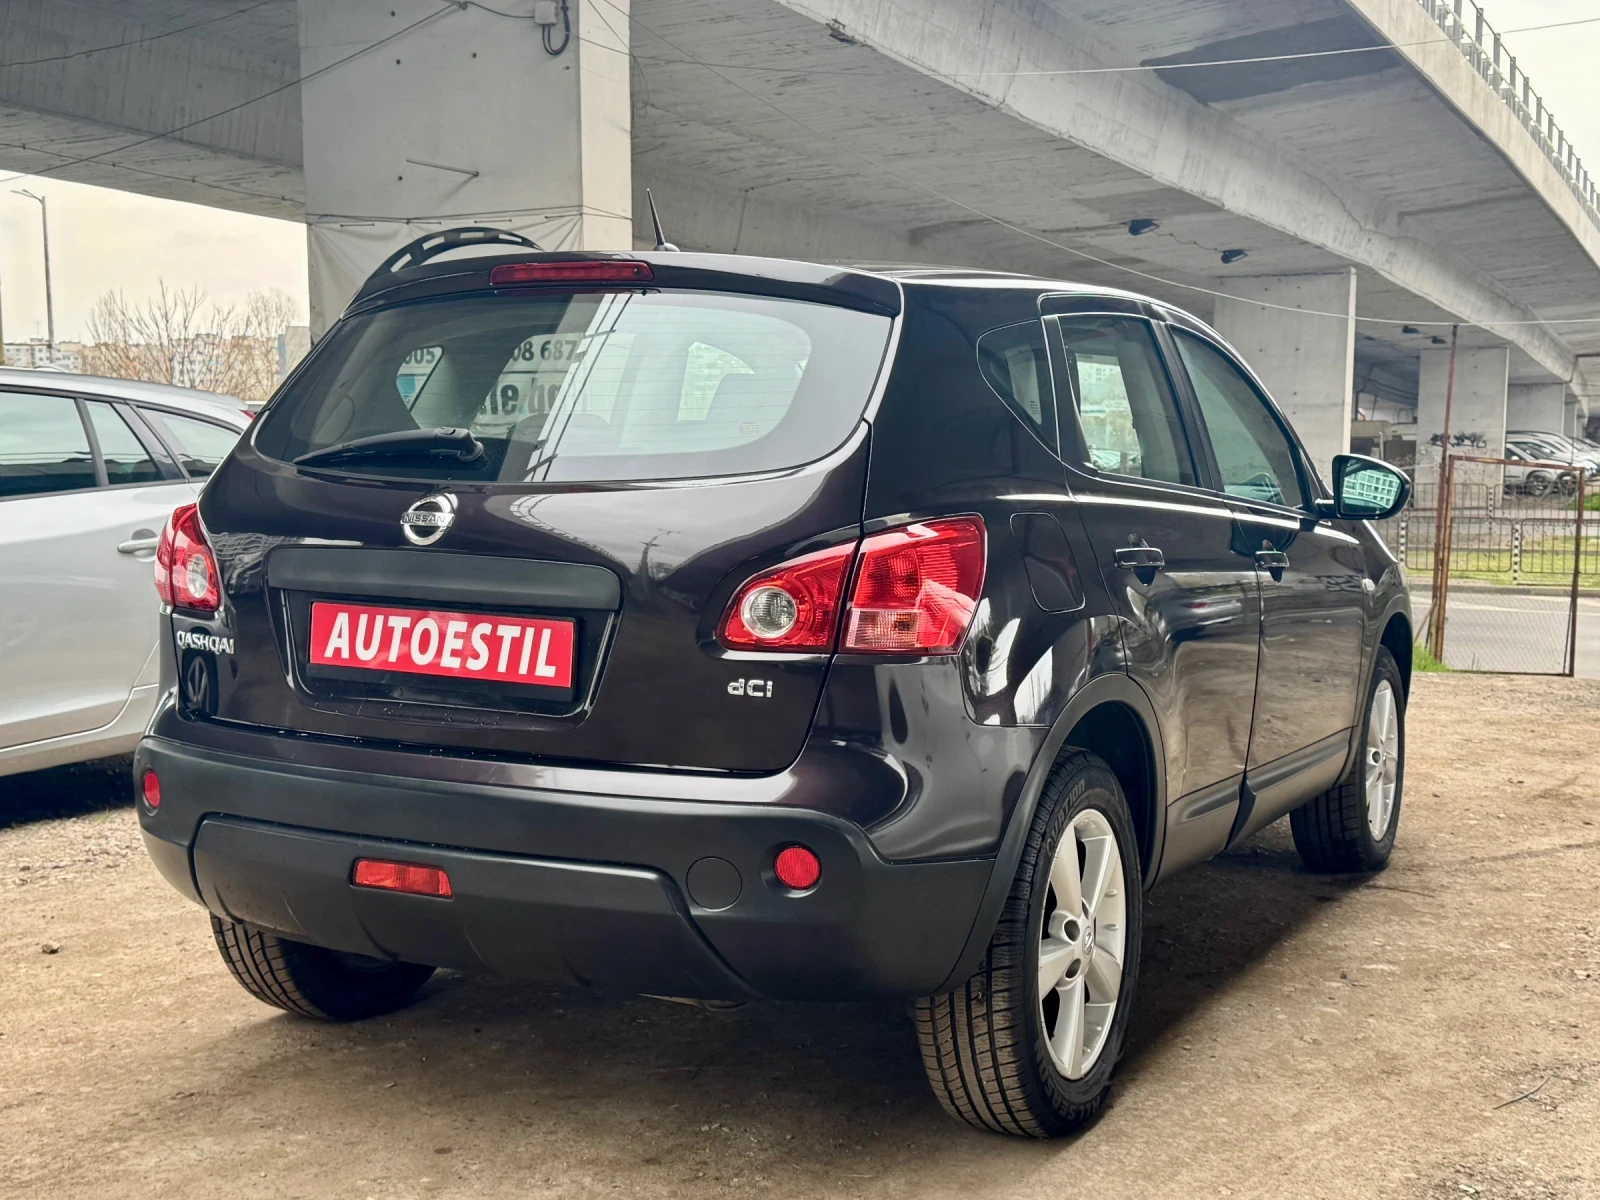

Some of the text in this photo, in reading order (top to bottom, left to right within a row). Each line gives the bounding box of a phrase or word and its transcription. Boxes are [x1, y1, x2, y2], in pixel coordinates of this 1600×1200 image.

[403, 513, 446, 524] NISSAN
[176, 630, 235, 655] QASHQAI
[323, 611, 557, 678] AUTOESTIL
[727, 678, 773, 698] dCi
[1046, 778, 1086, 858] OVATION
